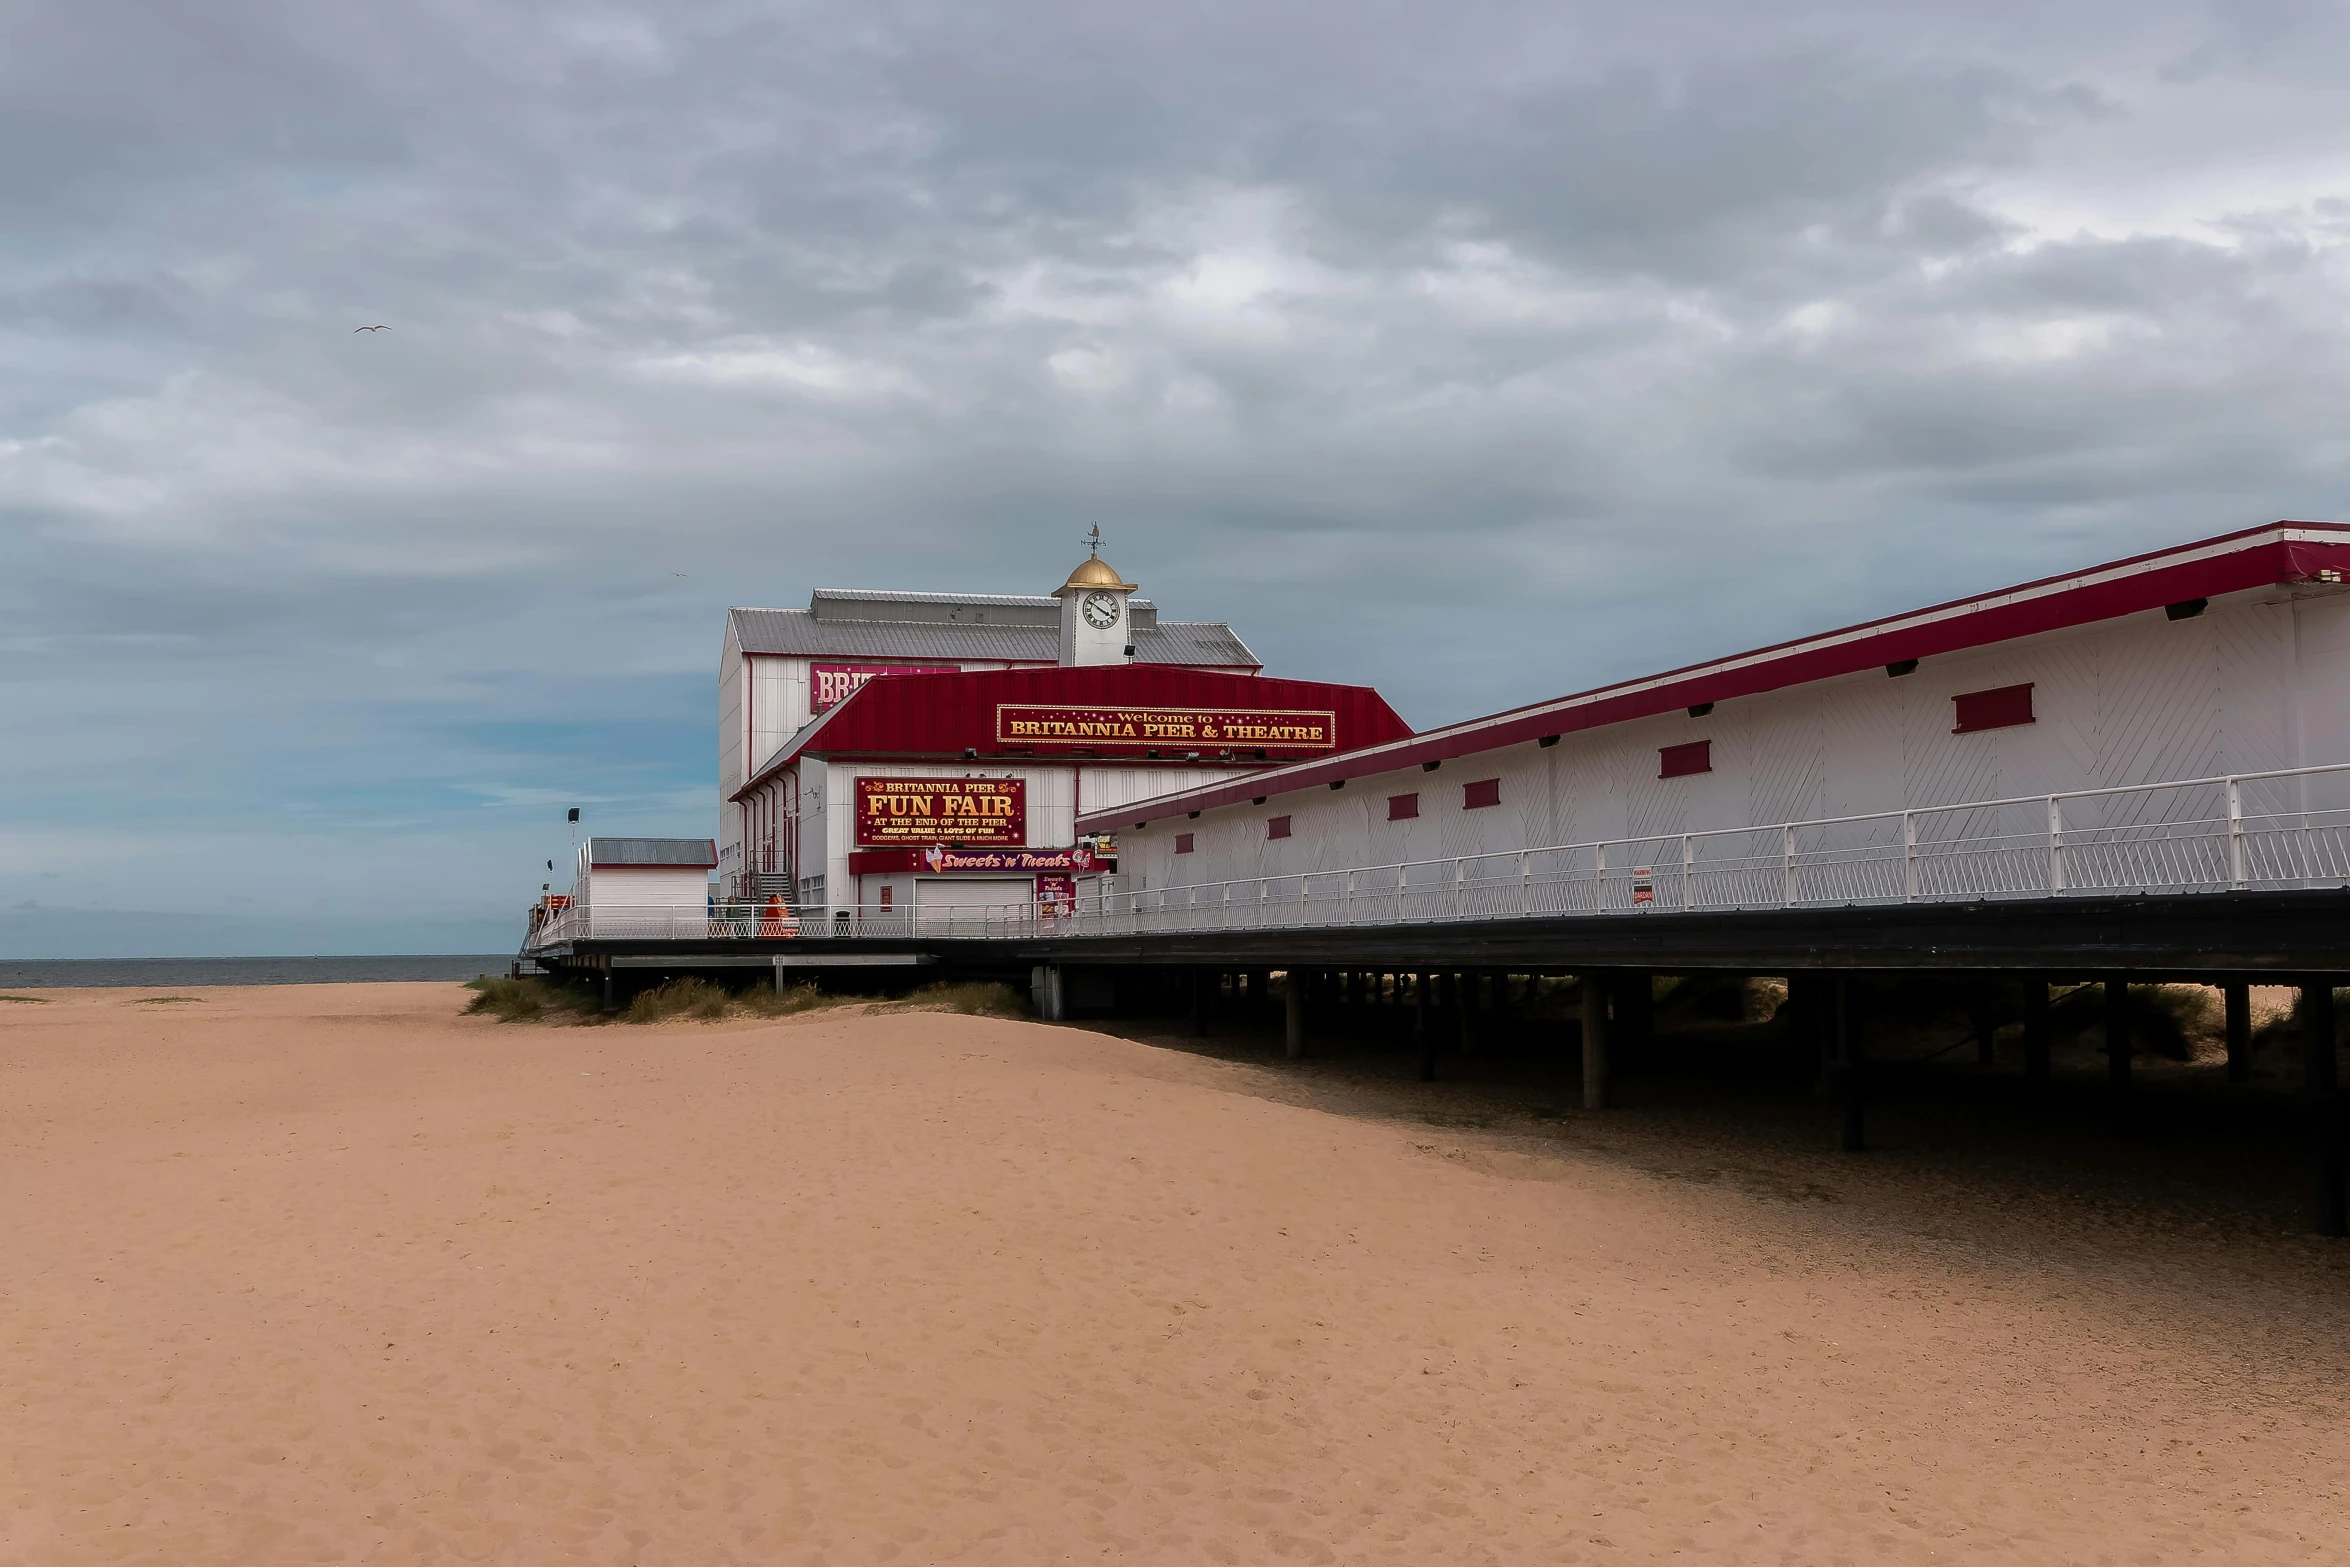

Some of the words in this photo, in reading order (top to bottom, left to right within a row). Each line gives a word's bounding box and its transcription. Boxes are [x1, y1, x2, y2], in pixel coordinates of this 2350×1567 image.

[1117, 713, 1194, 723] Welcome
[1198, 714, 1213, 724] to
[1010, 721, 1137, 737] BRITANNIA
[1143, 723, 1197, 738] PIER
[1202, 725, 1219, 739] &
[1223, 725, 1323, 740] THEATRE
[885, 783, 960, 793] BRITANNIA
[964, 783, 996, 793] PIER
[867, 795, 934, 816] FUN
[942, 795, 1015, 817] FAIR
[873, 818, 888, 826] AT
[890, 818, 912, 826] THE
[915, 818, 938, 826] END
[940, 818, 955, 826] OF
[957, 818, 979, 826] THE
[981, 818, 1008, 827] PIER
[941, 853, 1001, 868] Sweets
[1021, 853, 1071, 868] Treats
